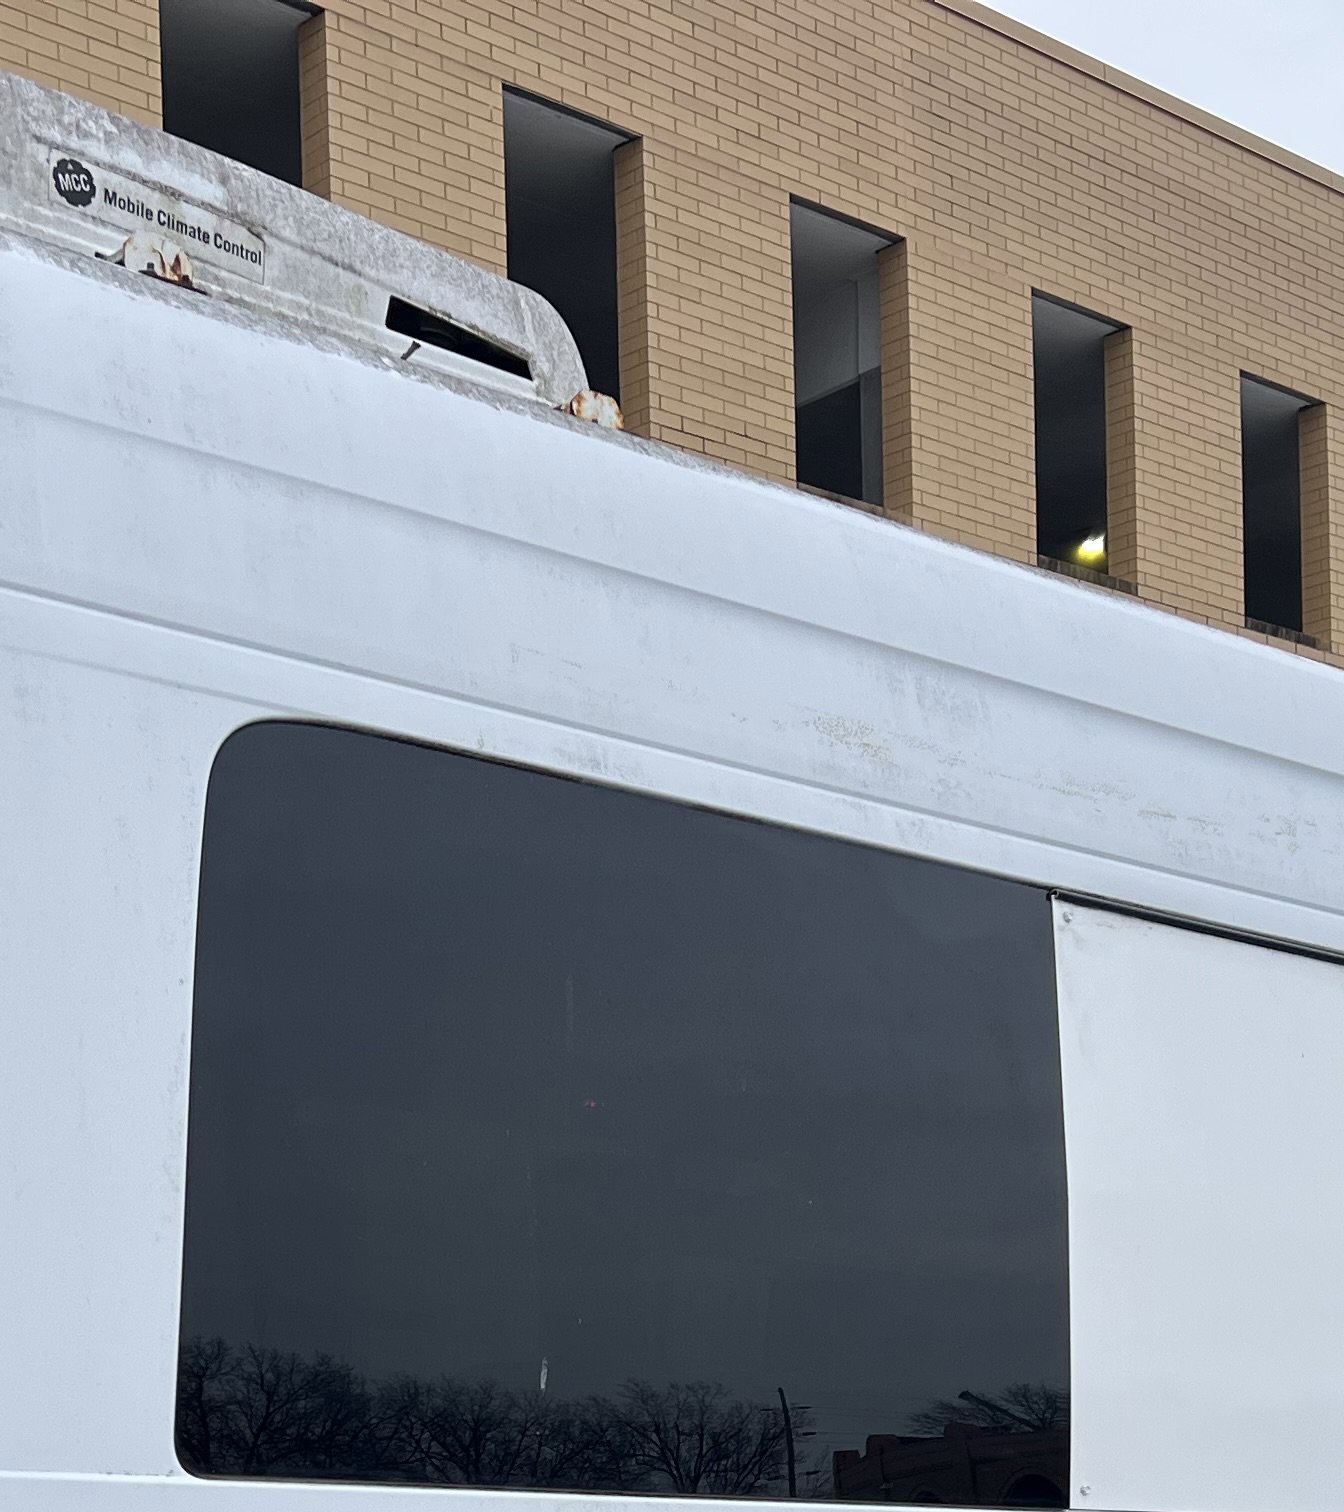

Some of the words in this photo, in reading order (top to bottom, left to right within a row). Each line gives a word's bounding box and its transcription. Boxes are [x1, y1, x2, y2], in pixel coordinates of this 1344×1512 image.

[57, 172, 91, 193] MCC
[103, 187, 154, 222] Mobile
[157, 210, 210, 245] Climate
[214, 232, 262, 266] Control
